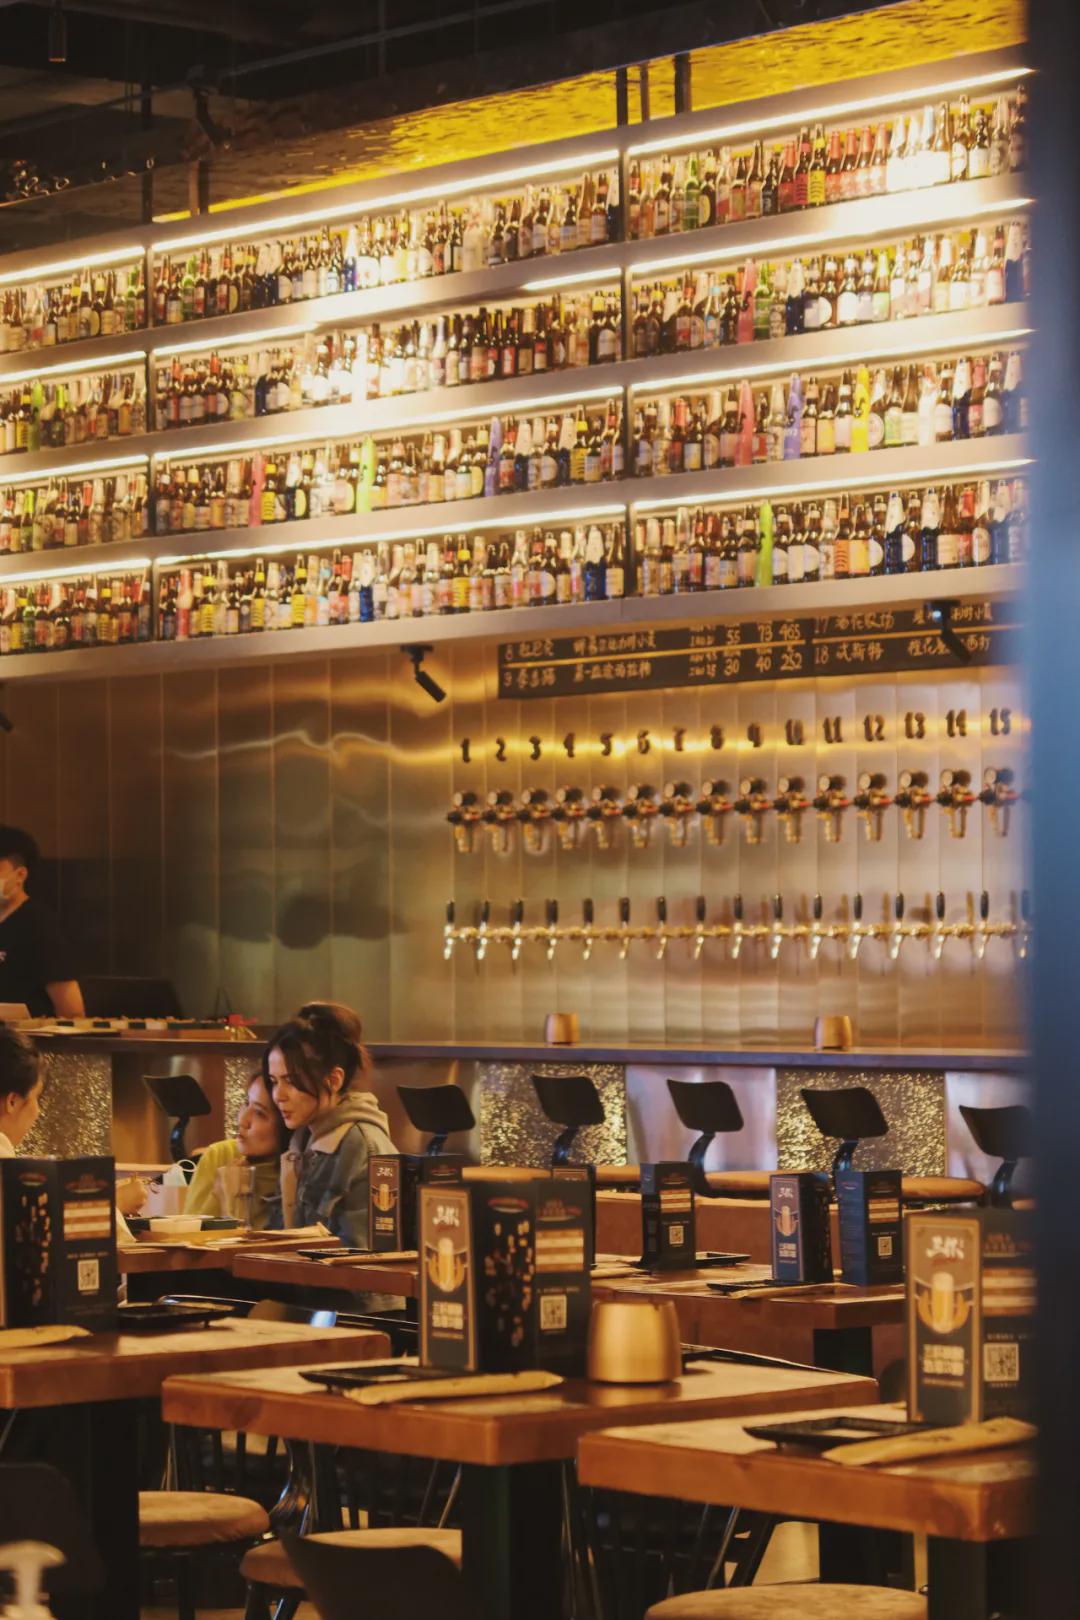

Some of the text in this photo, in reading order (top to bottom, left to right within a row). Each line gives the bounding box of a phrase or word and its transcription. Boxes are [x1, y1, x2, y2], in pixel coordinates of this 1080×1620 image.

[814, 645, 829, 664] 18
[724, 658, 740, 676] 30
[756, 655, 772, 673] 40
[495, 737, 507, 762] 2
[529, 735, 542, 761] 3
[563, 732, 576, 758] 4
[600, 732, 613, 756] 5
[637, 729, 650, 755] 6
[673, 727, 686, 751] 7
[824, 716, 843, 744] 11
[863, 714, 885, 742] 12
[904, 711, 925, 739] 13
[946, 709, 967, 738] 14
[989, 707, 1011, 736] 15
